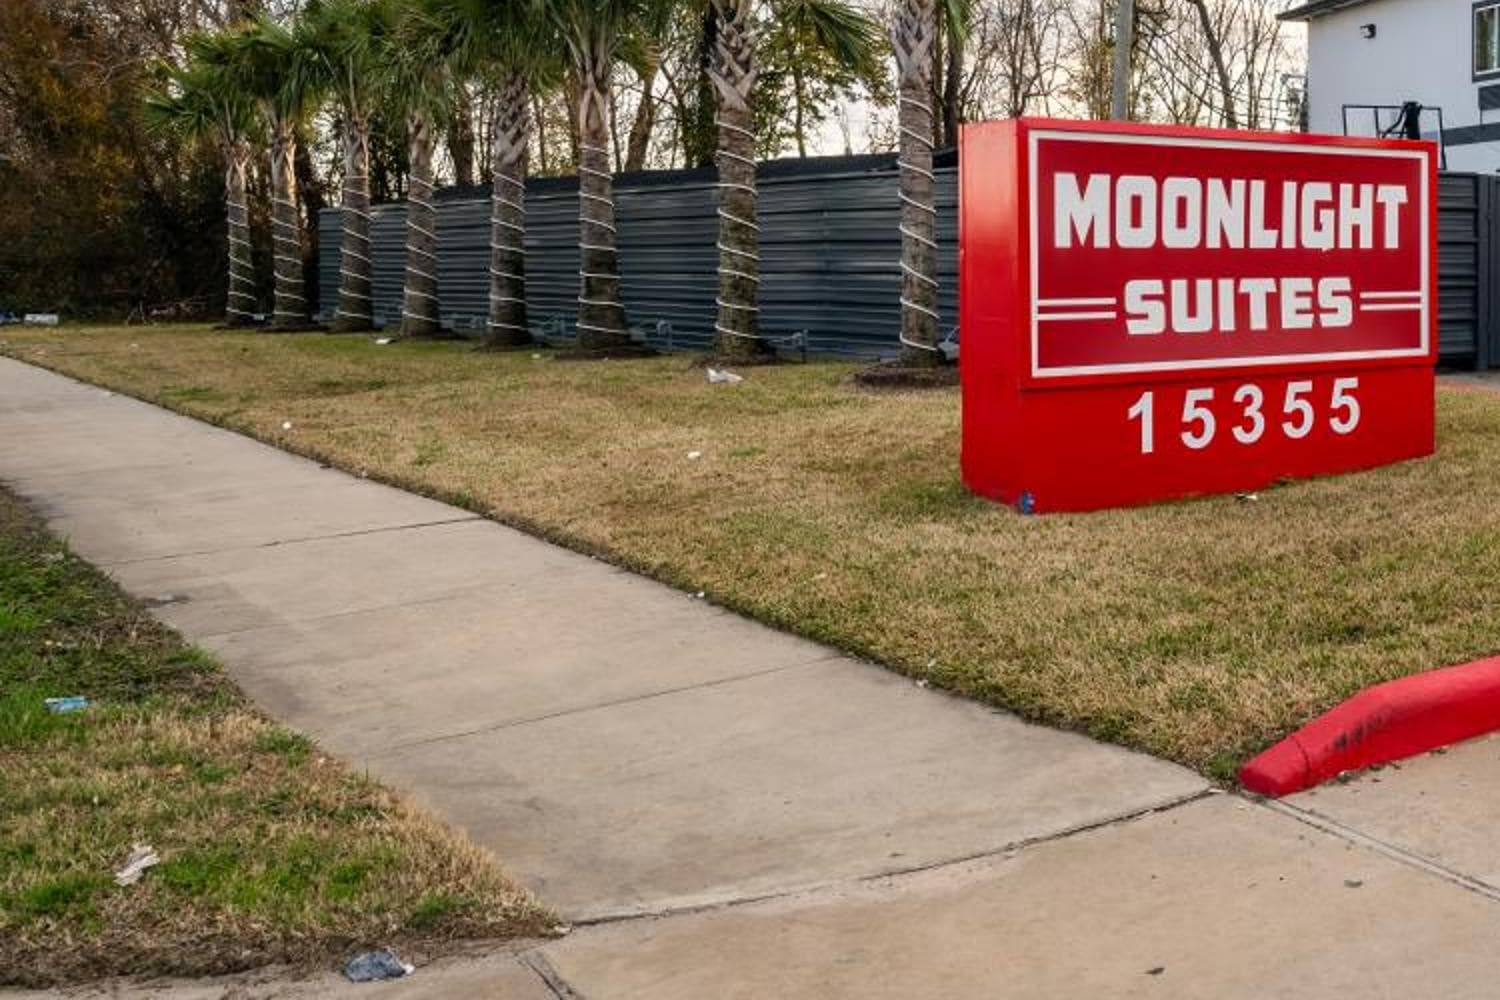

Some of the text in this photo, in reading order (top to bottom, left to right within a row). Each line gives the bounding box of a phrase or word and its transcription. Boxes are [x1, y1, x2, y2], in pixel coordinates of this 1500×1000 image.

[1053, 172, 1409, 251] MOONLIGHT
[1123, 276, 1353, 335] SUITES
[1126, 377, 1361, 453] 15355
